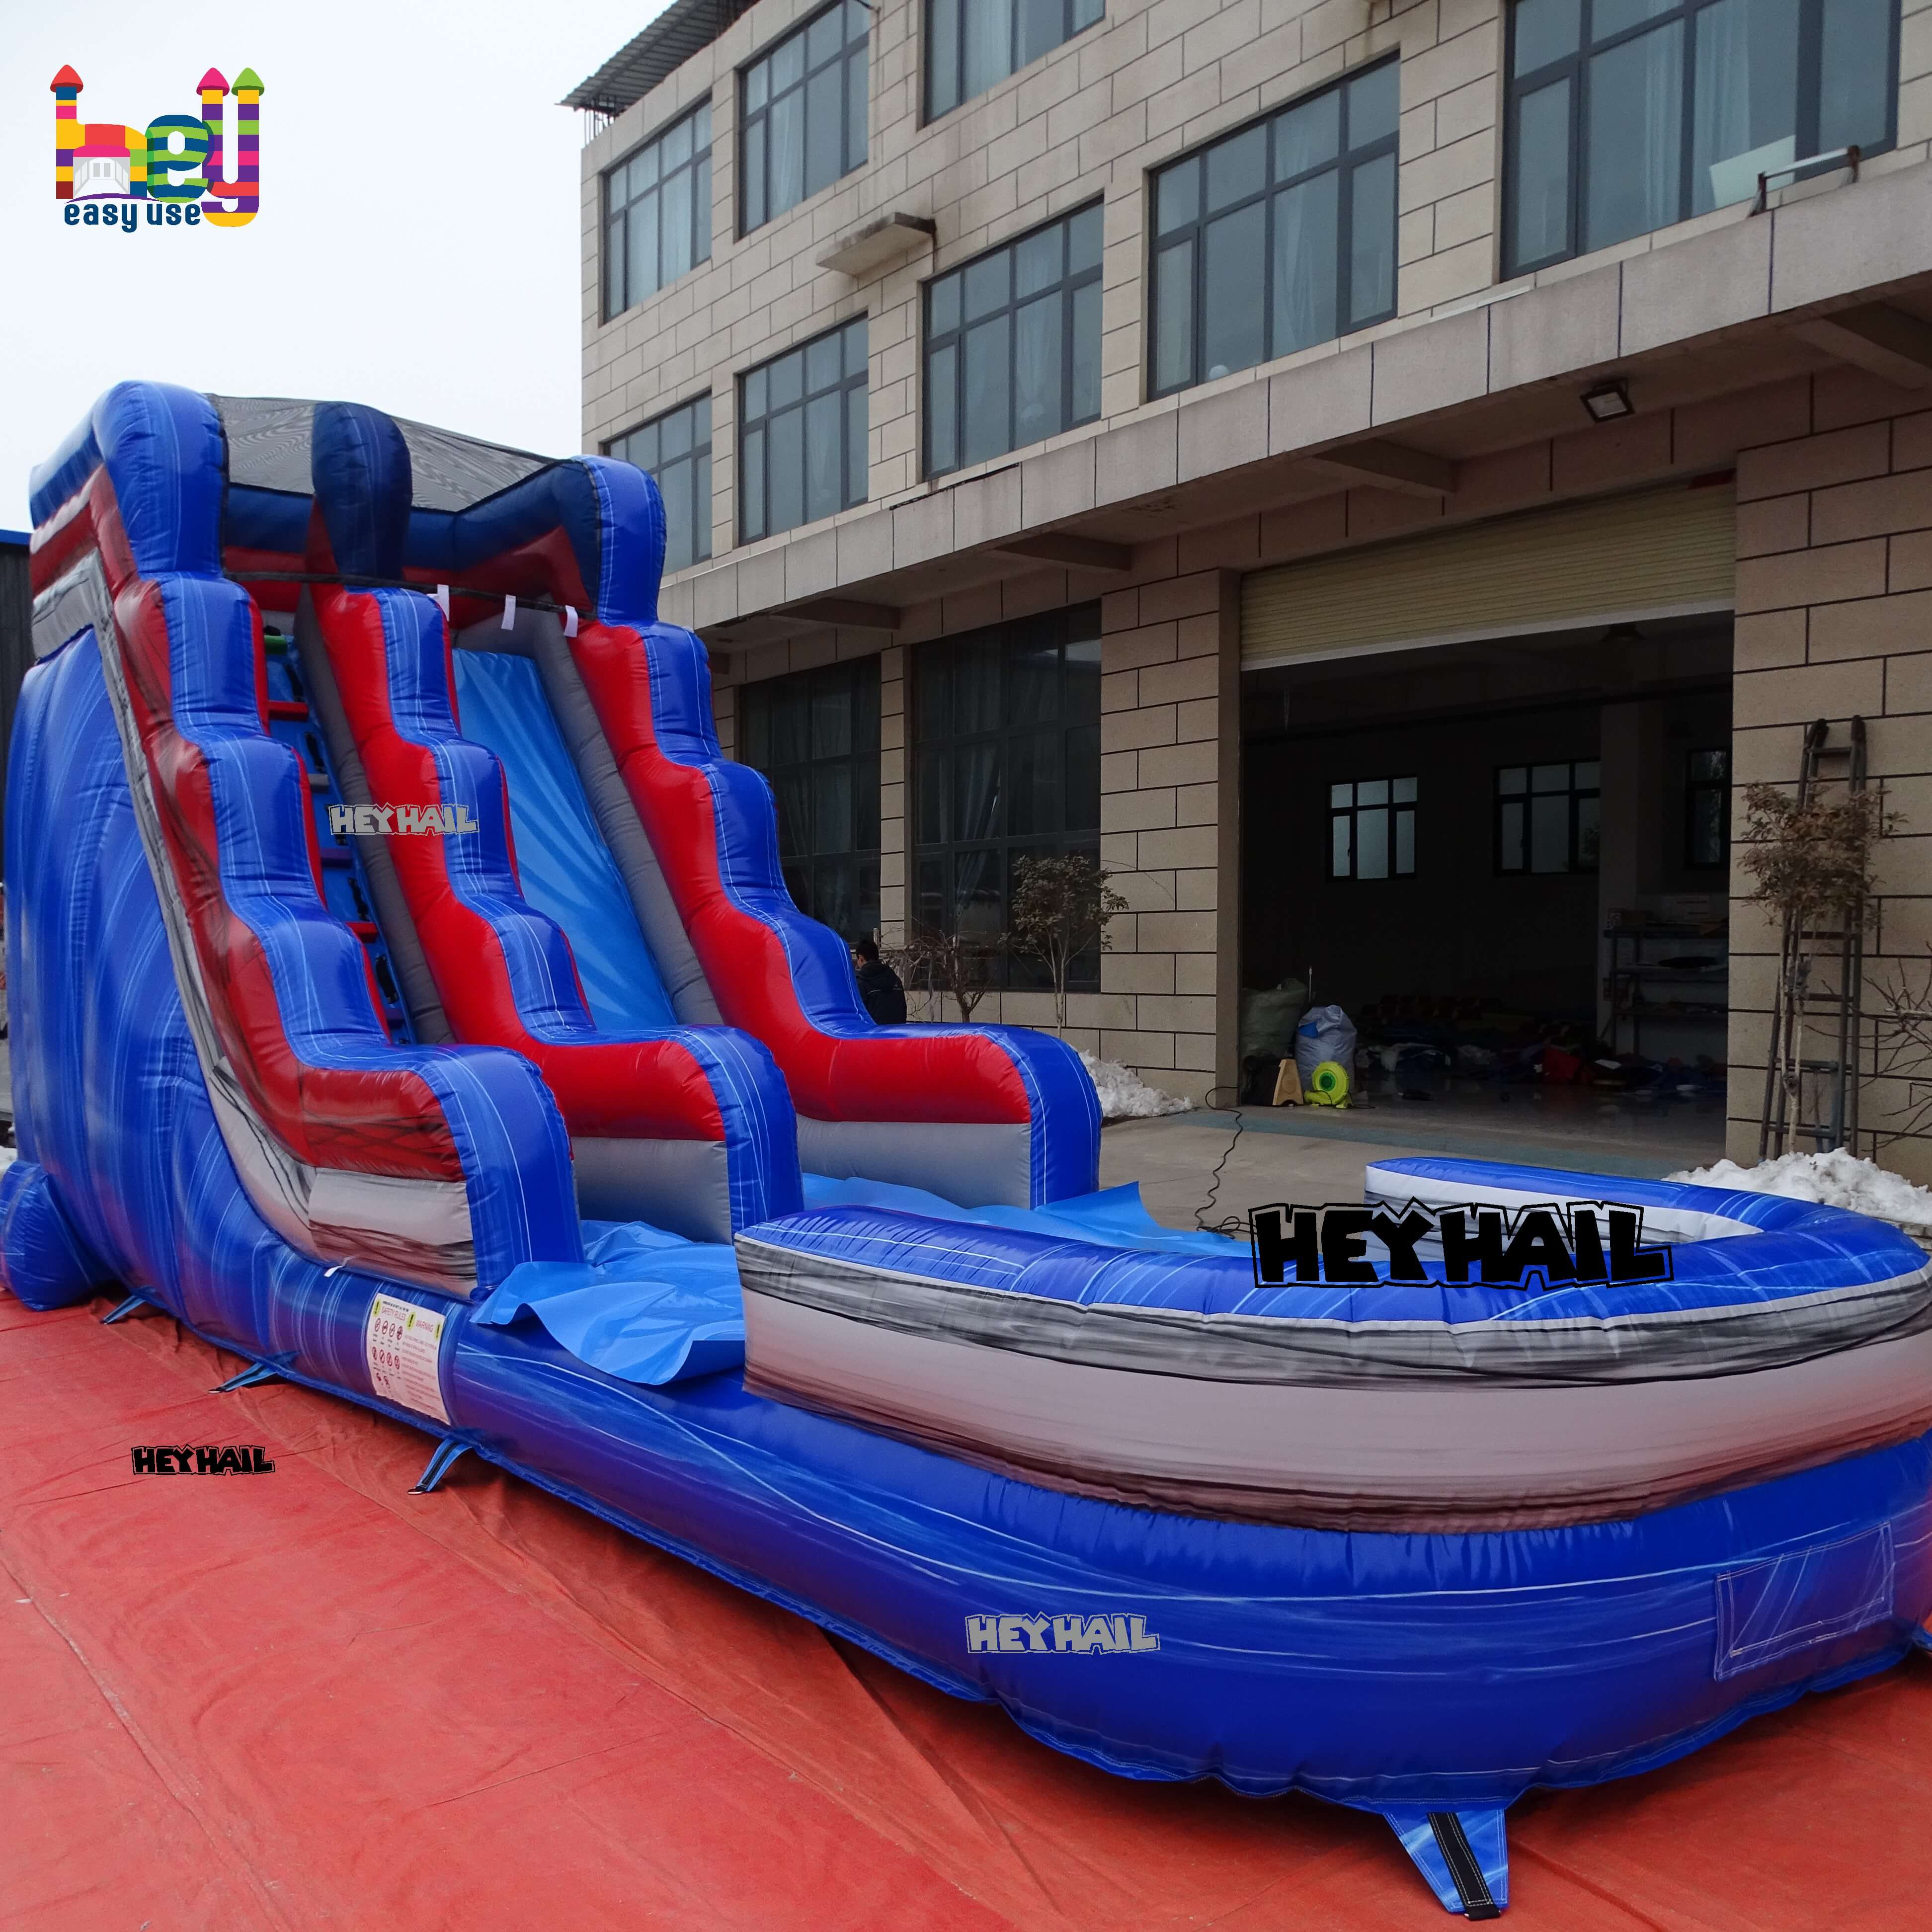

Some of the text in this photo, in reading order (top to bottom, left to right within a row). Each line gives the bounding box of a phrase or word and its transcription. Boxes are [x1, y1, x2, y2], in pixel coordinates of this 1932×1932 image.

[381, 1306, 395, 1316] SAFETY
[394, 1310, 406, 1321] RULES
[415, 1319, 434, 1333] WARNING
